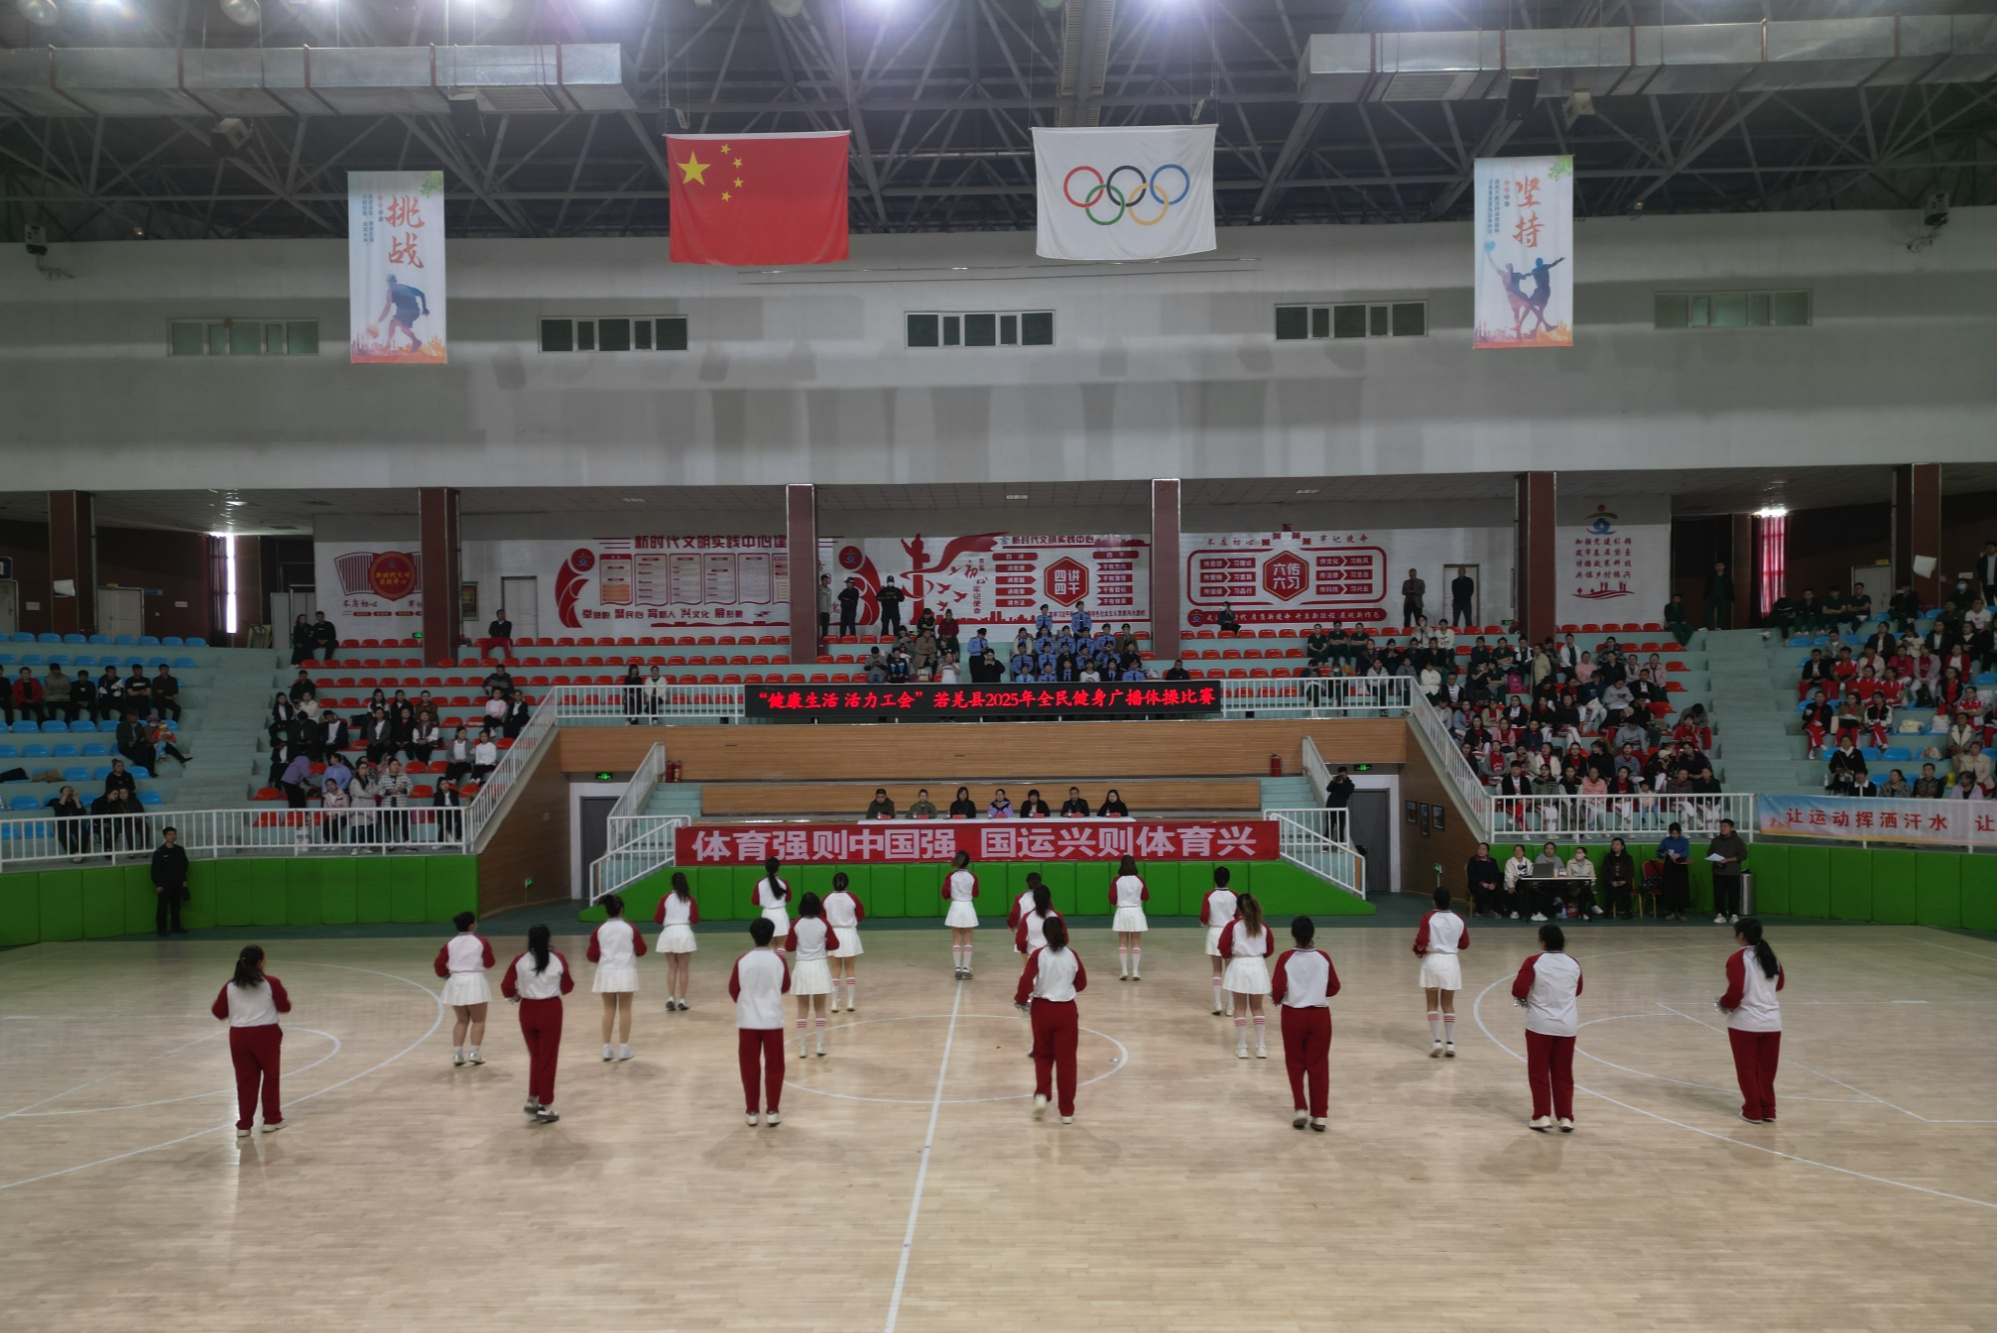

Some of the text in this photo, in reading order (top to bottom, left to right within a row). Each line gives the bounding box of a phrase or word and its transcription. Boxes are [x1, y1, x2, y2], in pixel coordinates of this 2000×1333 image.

[1512, 175, 1545, 248] 坚持
[385, 194, 425, 268] 挑战
[1012, 535, 1094, 545] 新时代文明实践中心
[1054, 569, 1080, 582] 四讲
[1273, 562, 1301, 576] 六传
[1054, 582, 1080, 595] 四干
[1273, 576, 1301, 590] 六习
[650, 608, 676, 619] 育新人
[681, 607, 710, 619] 兴文化
[714, 607, 744, 619] 展形象
[759, 687, 1216, 710] “健康生活 活力工会” 若羌县2025年全民健身广播体操比赛
[1786, 807, 1948, 832] 让运动挥洒汗水
[691, 825, 1257, 862] 体育强则中国强 国运兴则体育兴
